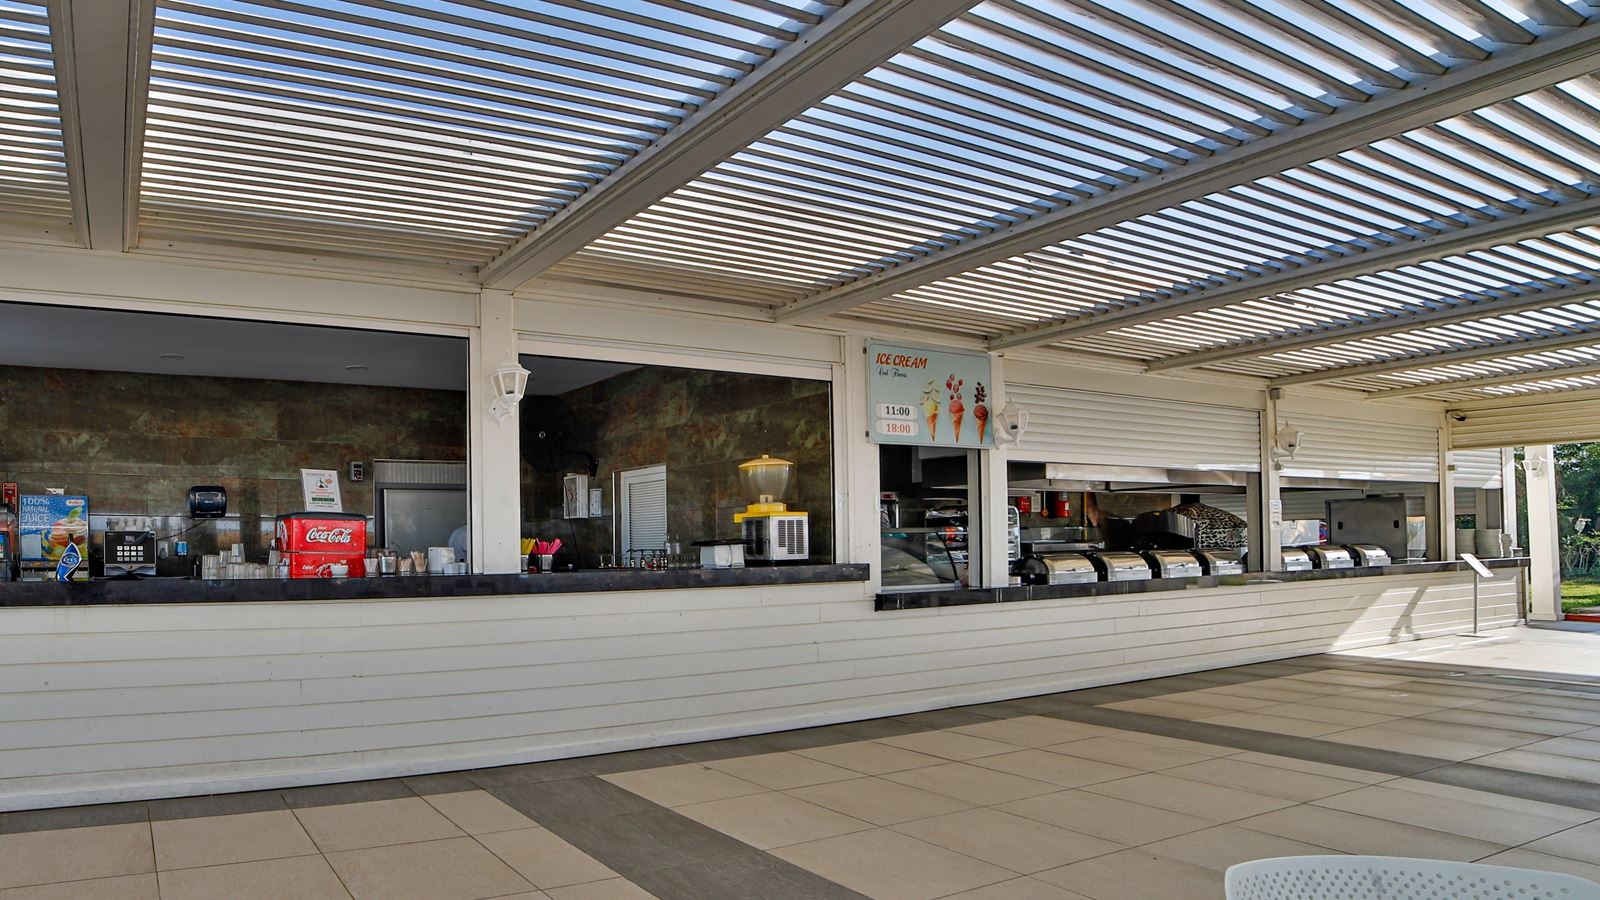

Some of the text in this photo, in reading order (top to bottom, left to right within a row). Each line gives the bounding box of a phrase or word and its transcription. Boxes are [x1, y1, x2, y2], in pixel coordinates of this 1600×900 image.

[875, 353, 928, 369] ICE CREAM
[885, 405, 910, 417] 11:00
[886, 423, 911, 434] 18:00
[21, 497, 50, 505] 100%
[21, 513, 50, 523] JUICE
[305, 527, 353, 544] Coca-Cola
